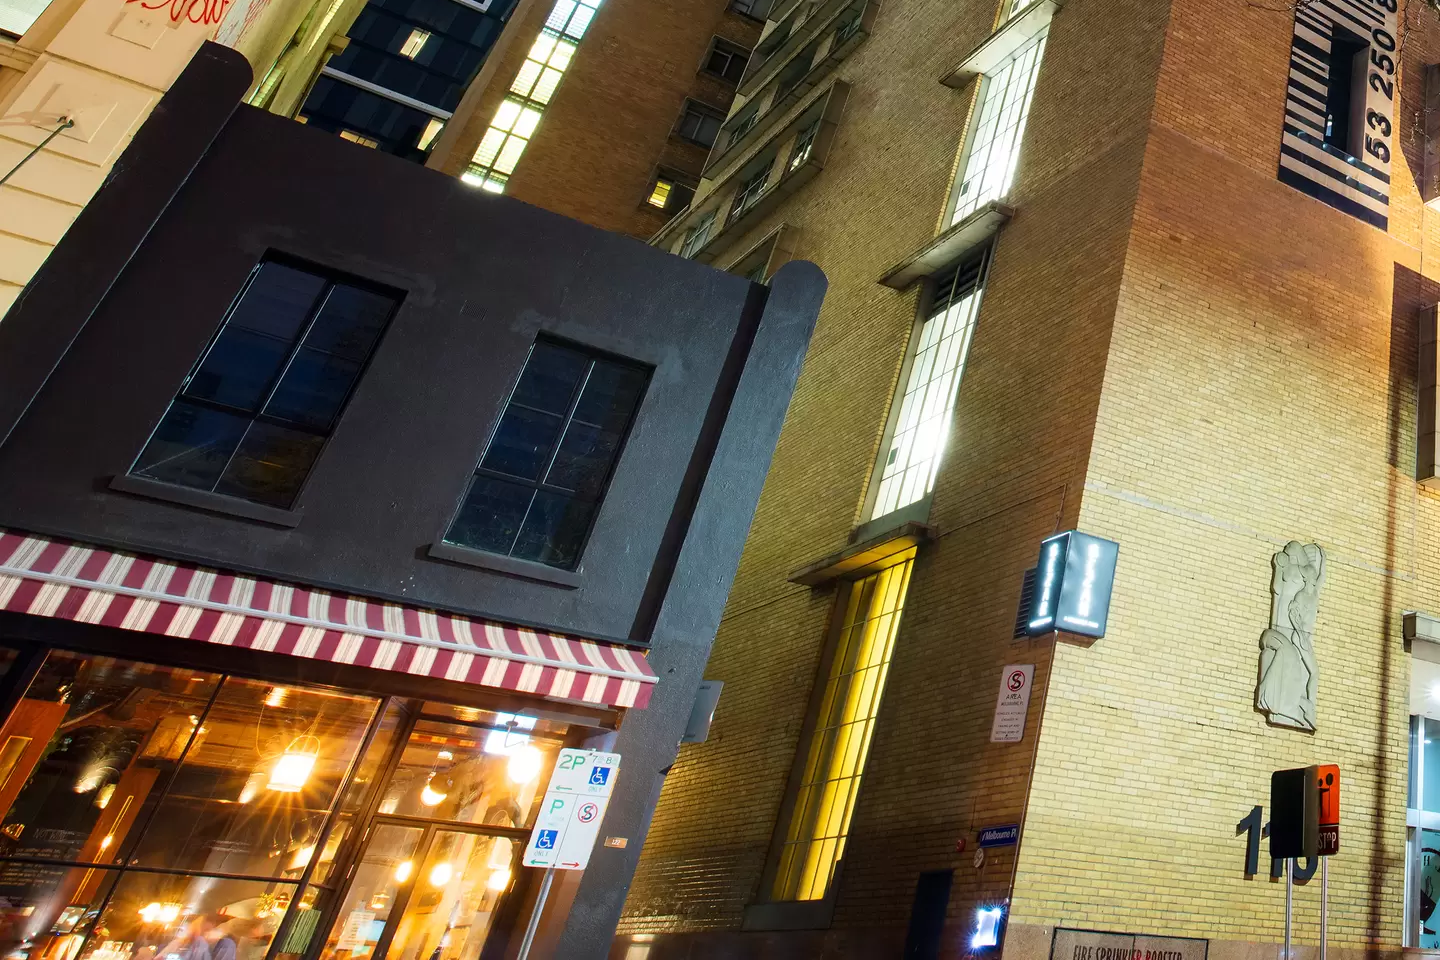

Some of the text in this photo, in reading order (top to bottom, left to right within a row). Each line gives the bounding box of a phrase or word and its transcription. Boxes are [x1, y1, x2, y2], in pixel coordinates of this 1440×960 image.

[1368, 28, 1397, 102] 250
[1365, 107, 1391, 164] 53
[558, 753, 586, 770] 2P
[984, 830, 1010, 841] Melbourne
